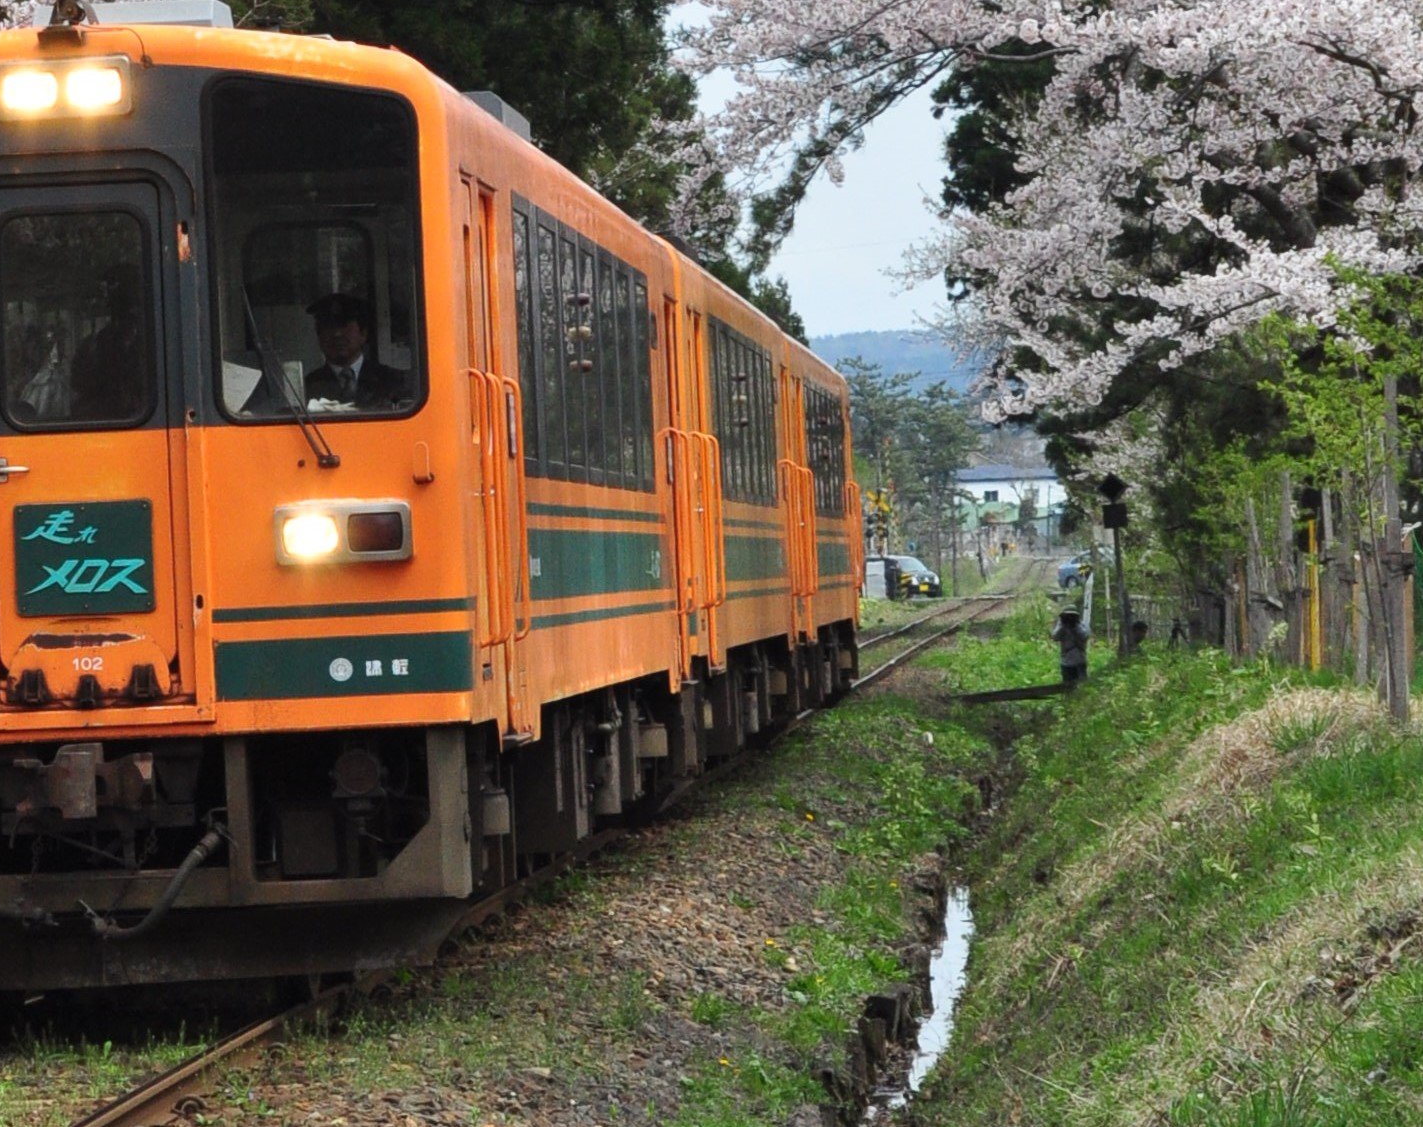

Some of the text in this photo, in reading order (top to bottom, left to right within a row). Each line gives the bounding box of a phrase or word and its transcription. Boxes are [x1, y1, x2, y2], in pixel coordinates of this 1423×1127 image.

[21, 510, 98, 544] 走れ
[26, 559, 149, 595] メロス
[72, 657, 103, 671] 102
